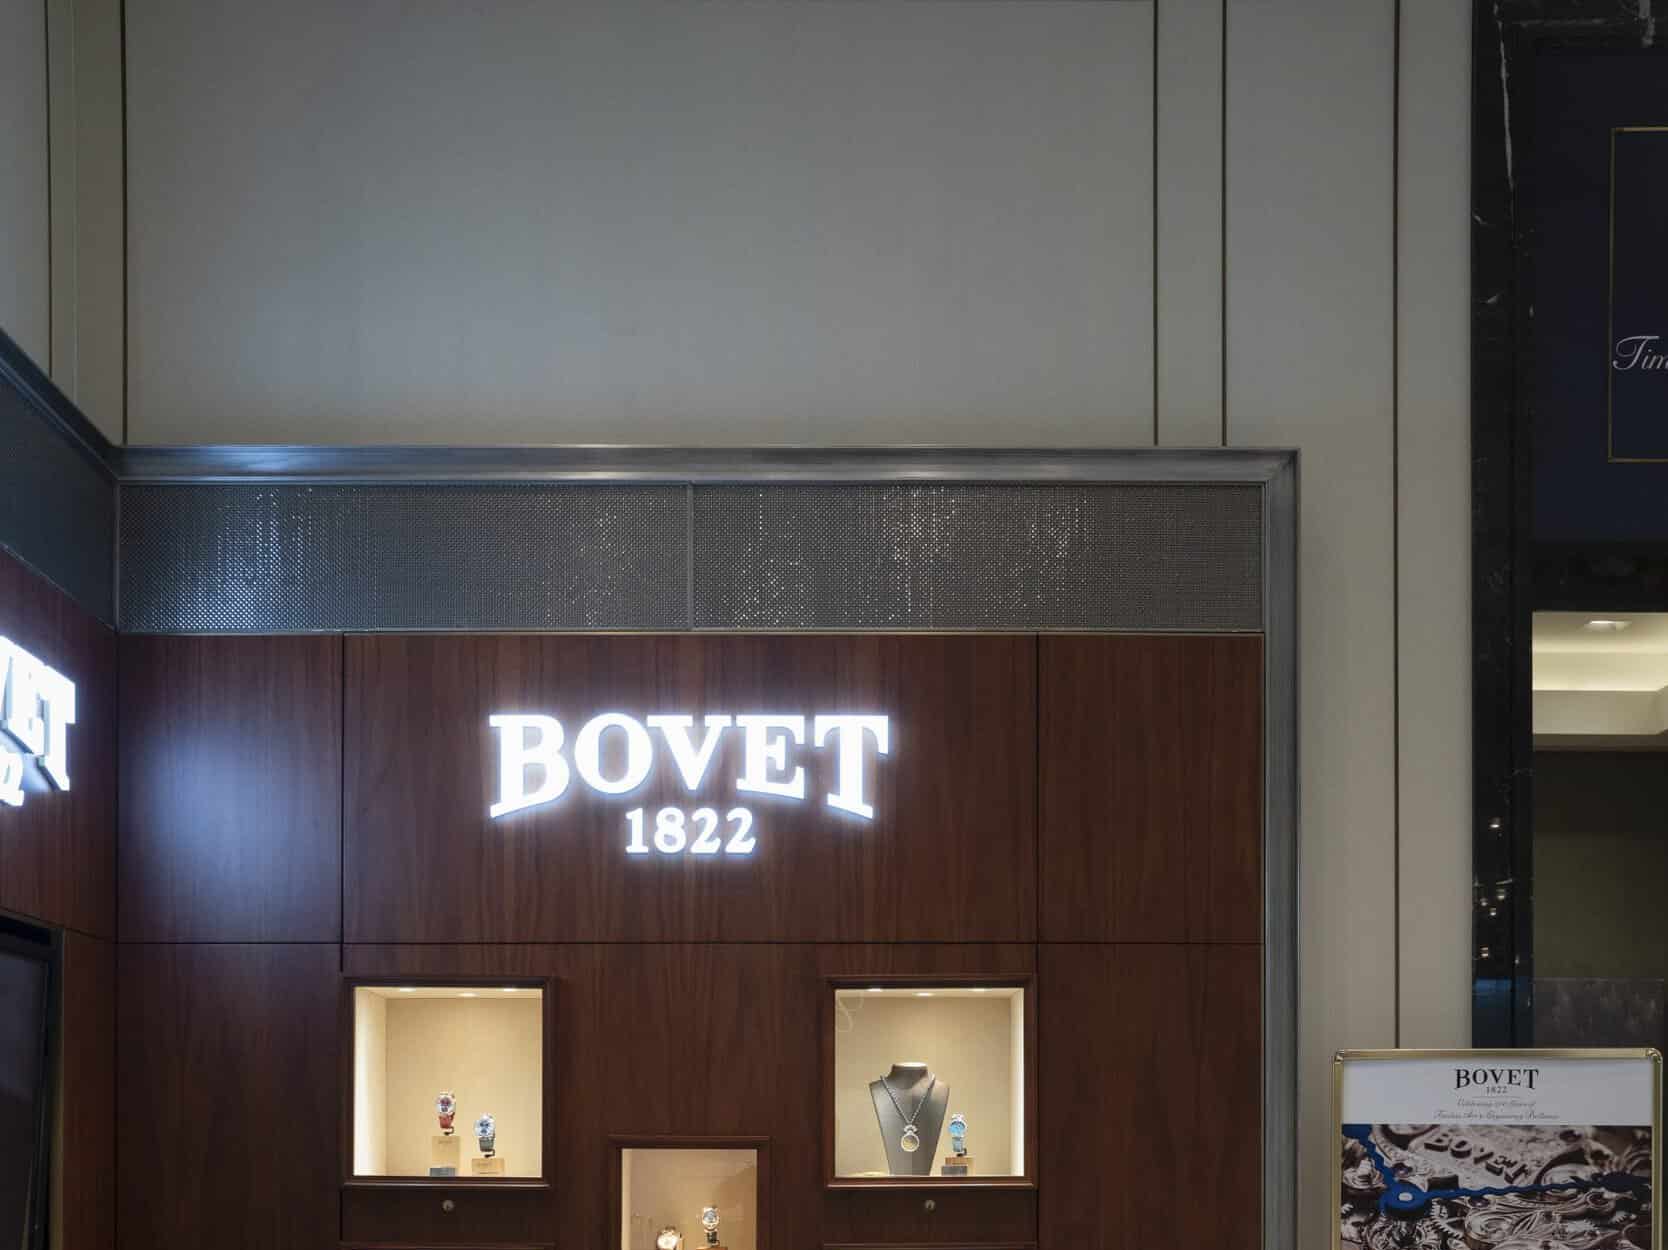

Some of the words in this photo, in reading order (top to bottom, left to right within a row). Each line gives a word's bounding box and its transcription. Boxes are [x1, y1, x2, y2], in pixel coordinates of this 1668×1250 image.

[489, 712, 889, 820] BOVET
[625, 806, 757, 854] 1822
[1454, 1068, 1540, 1090] BOVET
[1425, 1129, 1532, 1184] BOVET
